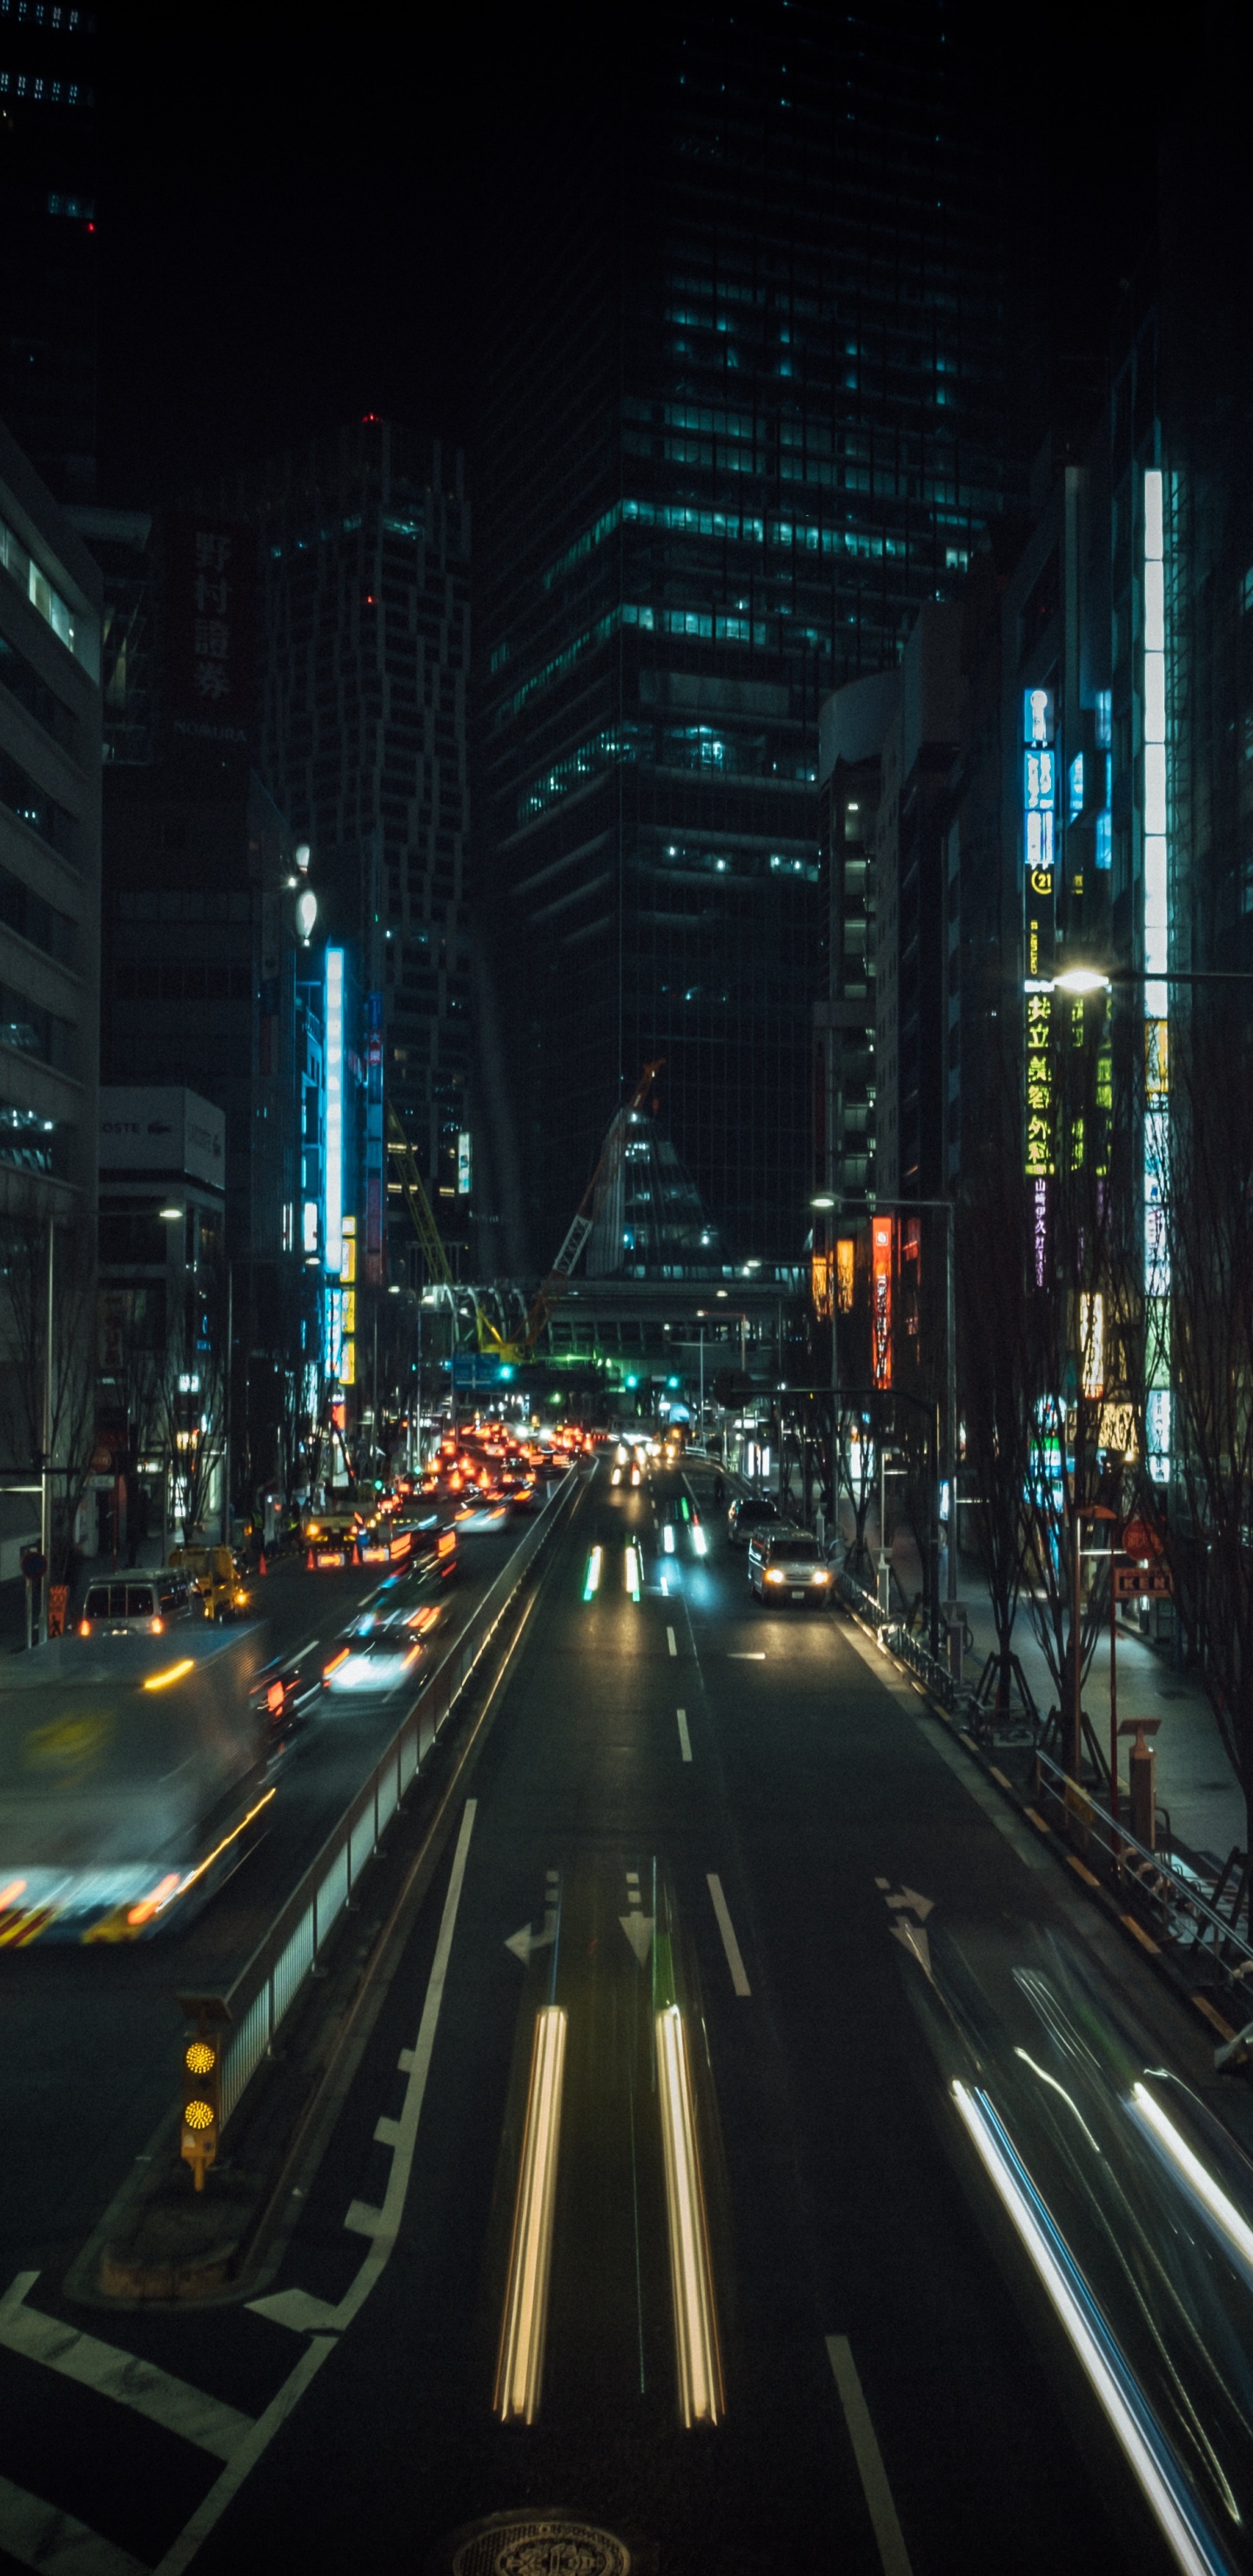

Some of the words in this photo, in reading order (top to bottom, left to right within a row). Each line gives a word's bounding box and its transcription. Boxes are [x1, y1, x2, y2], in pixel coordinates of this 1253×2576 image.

[194, 531, 231, 699] 野村證券
[173, 720, 247, 742] NOMURA
[99, 1122, 140, 1133] OSTE
